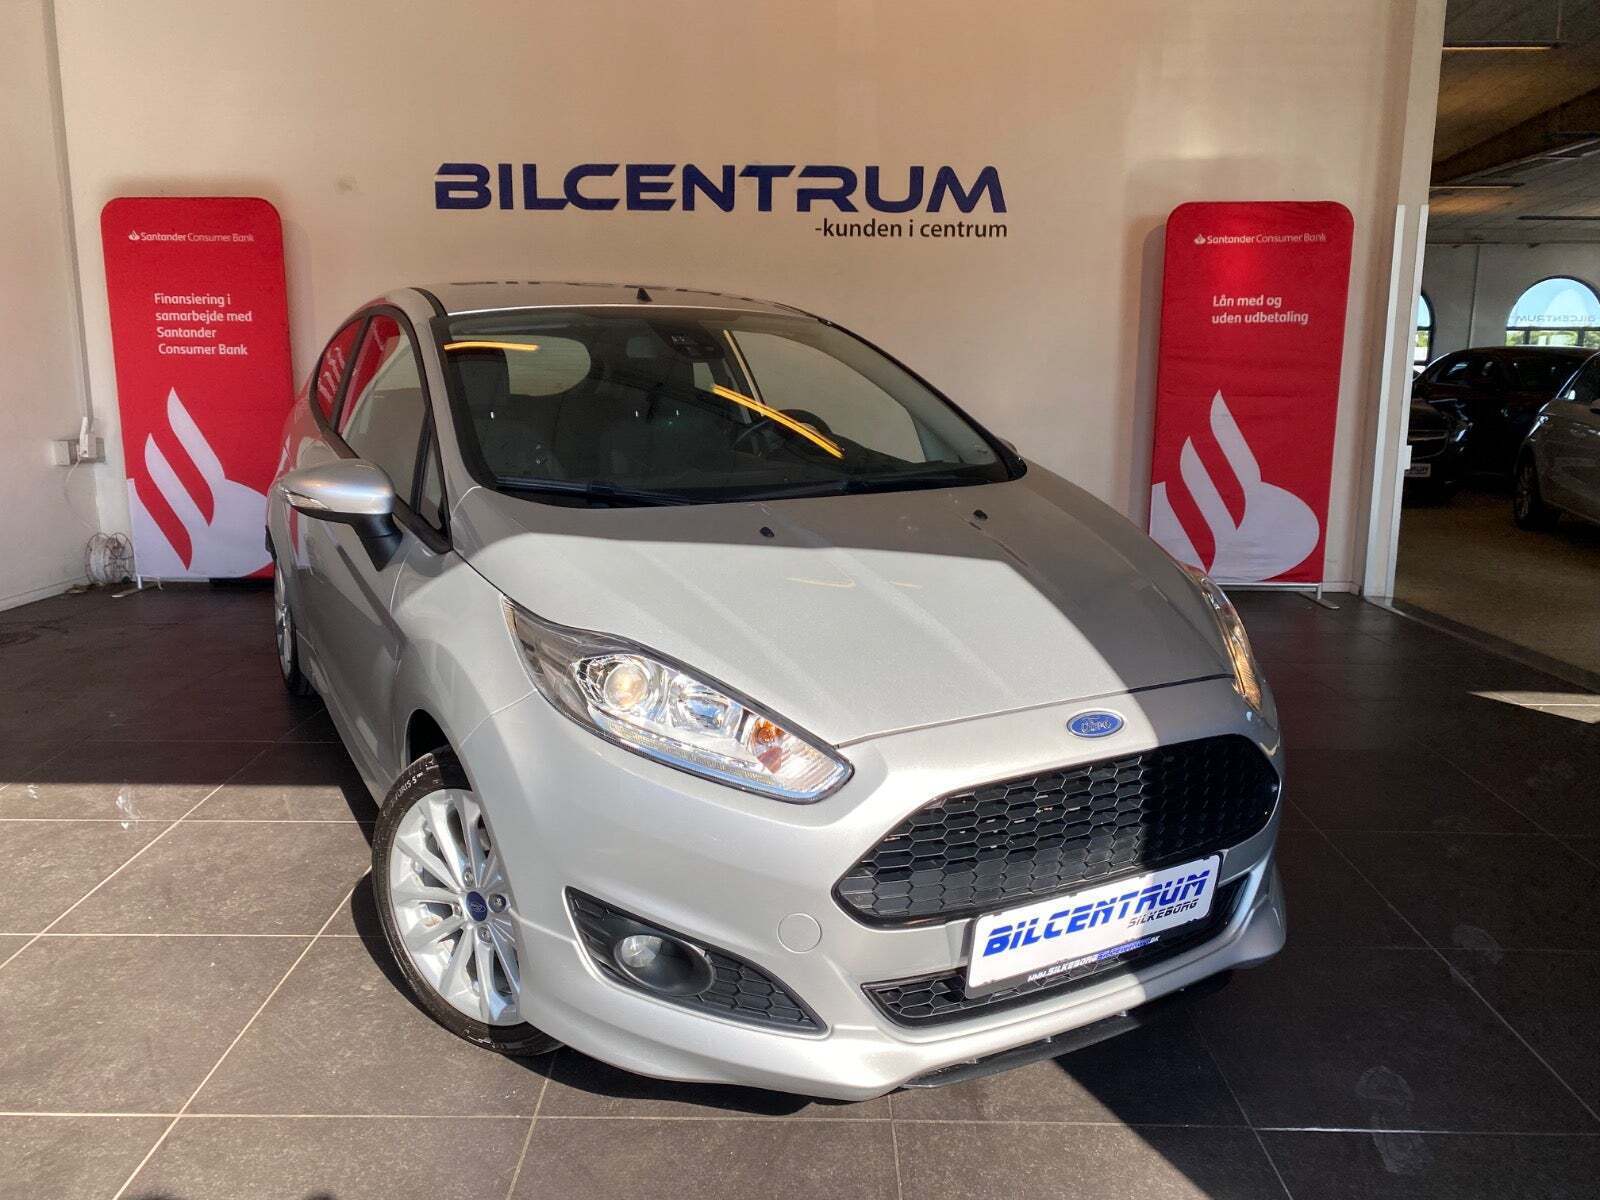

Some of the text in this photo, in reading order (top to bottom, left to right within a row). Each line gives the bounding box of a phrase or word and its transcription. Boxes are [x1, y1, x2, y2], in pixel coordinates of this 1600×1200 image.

[434, 162, 1007, 214] BILCENTRUM
[815, 217, 1008, 238] -kunden i centrum
[140, 231, 254, 243] Santander Consumer Bank
[1206, 232, 1327, 244] Santander Consumer Bank
[154, 293, 225, 307] Finansiering
[1212, 294, 1283, 309] Lån med og
[155, 310, 253, 324] samarbejde med
[1211, 311, 1309, 325] uden udbetaling
[156, 326, 217, 338] Santander
[158, 342, 248, 356] Consumer Bank
[983, 869, 1210, 958] BILCENTRUM
[1127, 898, 1200, 929] SILKEBORG
